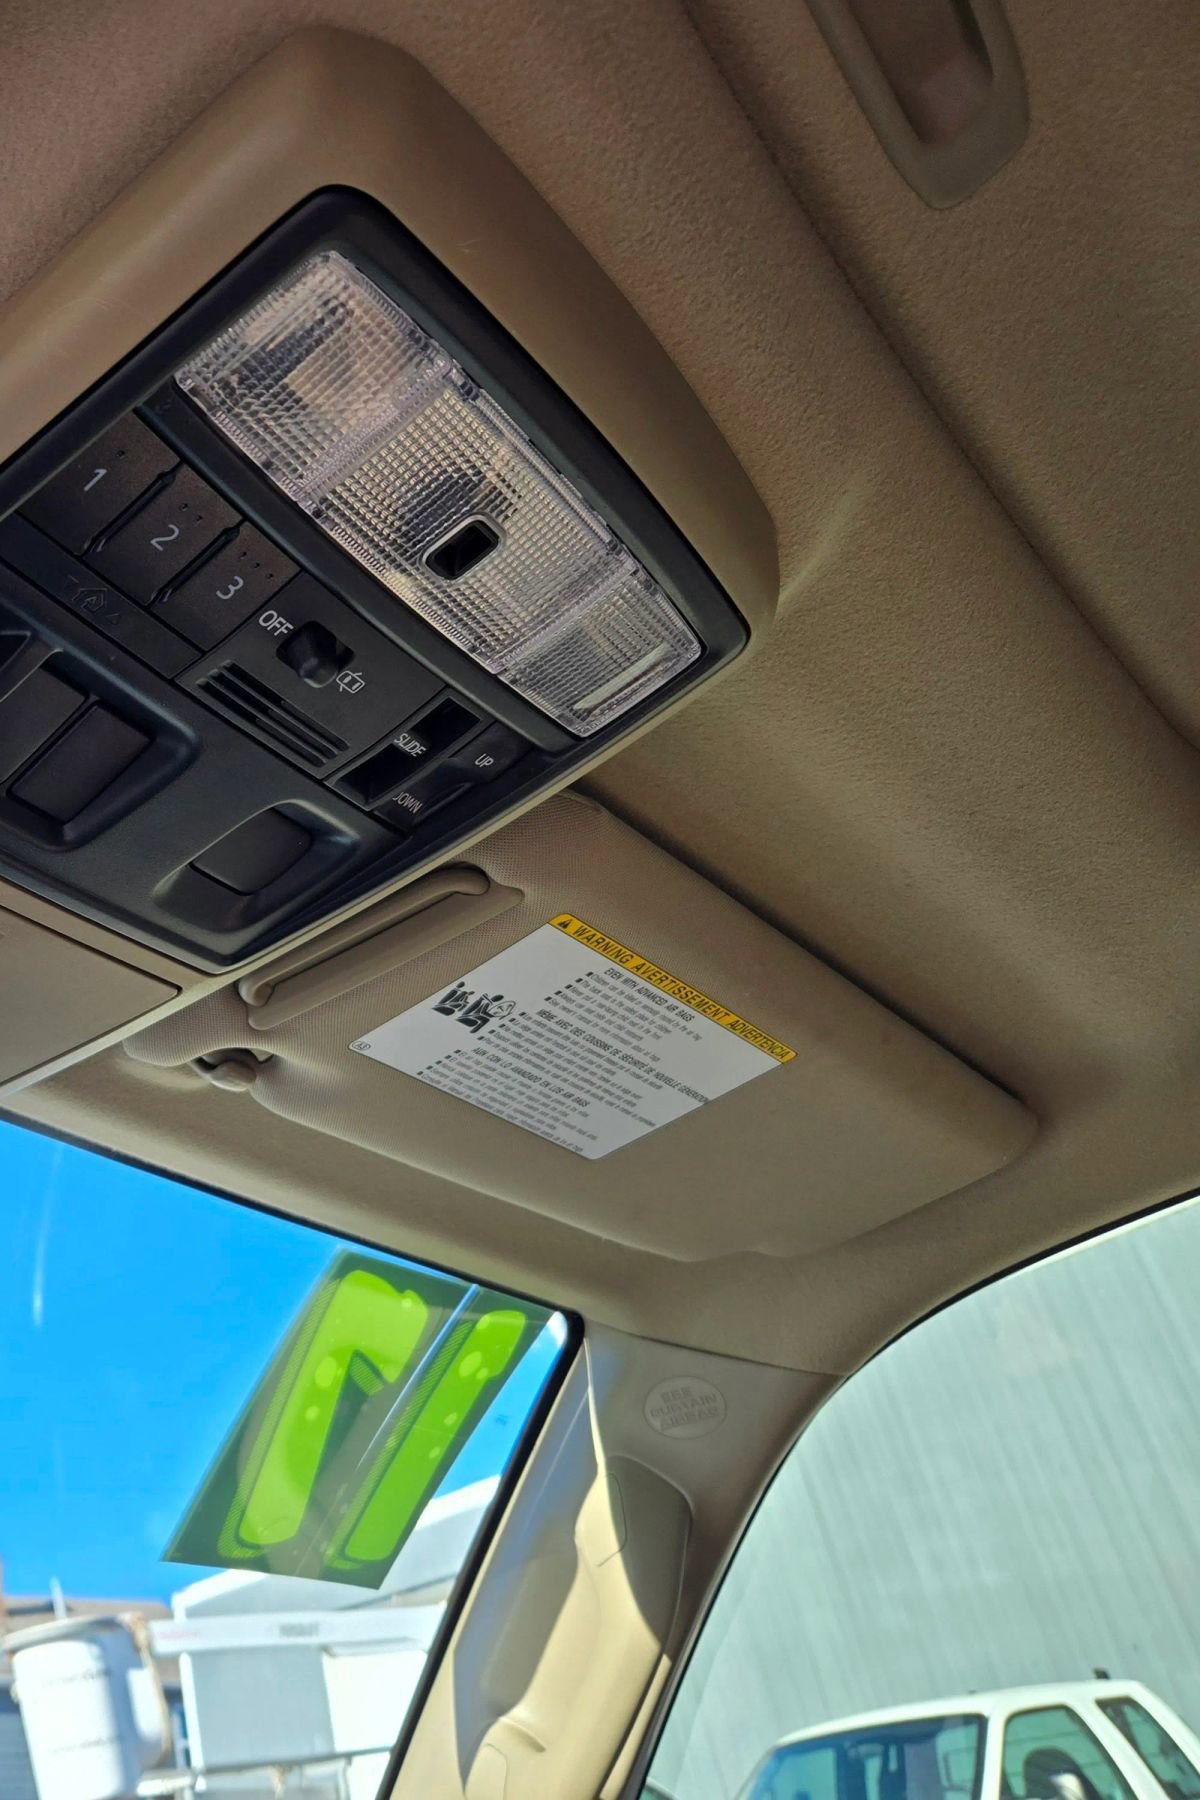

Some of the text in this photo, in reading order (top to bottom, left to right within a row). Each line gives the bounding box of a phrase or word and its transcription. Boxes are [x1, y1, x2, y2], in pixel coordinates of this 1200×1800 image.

[84, 468, 107, 492] 1
[150, 523, 180, 550] 2
[215, 575, 244, 600] 3
[258, 609, 294, 638] OFF
[393, 733, 427, 757] SLIDE
[474, 753, 494, 768] UP
[569, 924, 636, 965] WARNING
[629, 961, 731, 1021] AVERTISSEMENT
[724, 1018, 793, 1059] ADVERTENCIA
[602, 967, 697, 1022] EVEN WITH ADVANCED AIR BAGS
[567, 1026, 587, 1037] DES
[483, 1053, 504, 1064] CON
[497, 1060, 514, 1069] LO
[537, 1080, 553, 1088] EN
[546, 1084, 565, 1094] LOS
[559, 1090, 576, 1099] AIR
